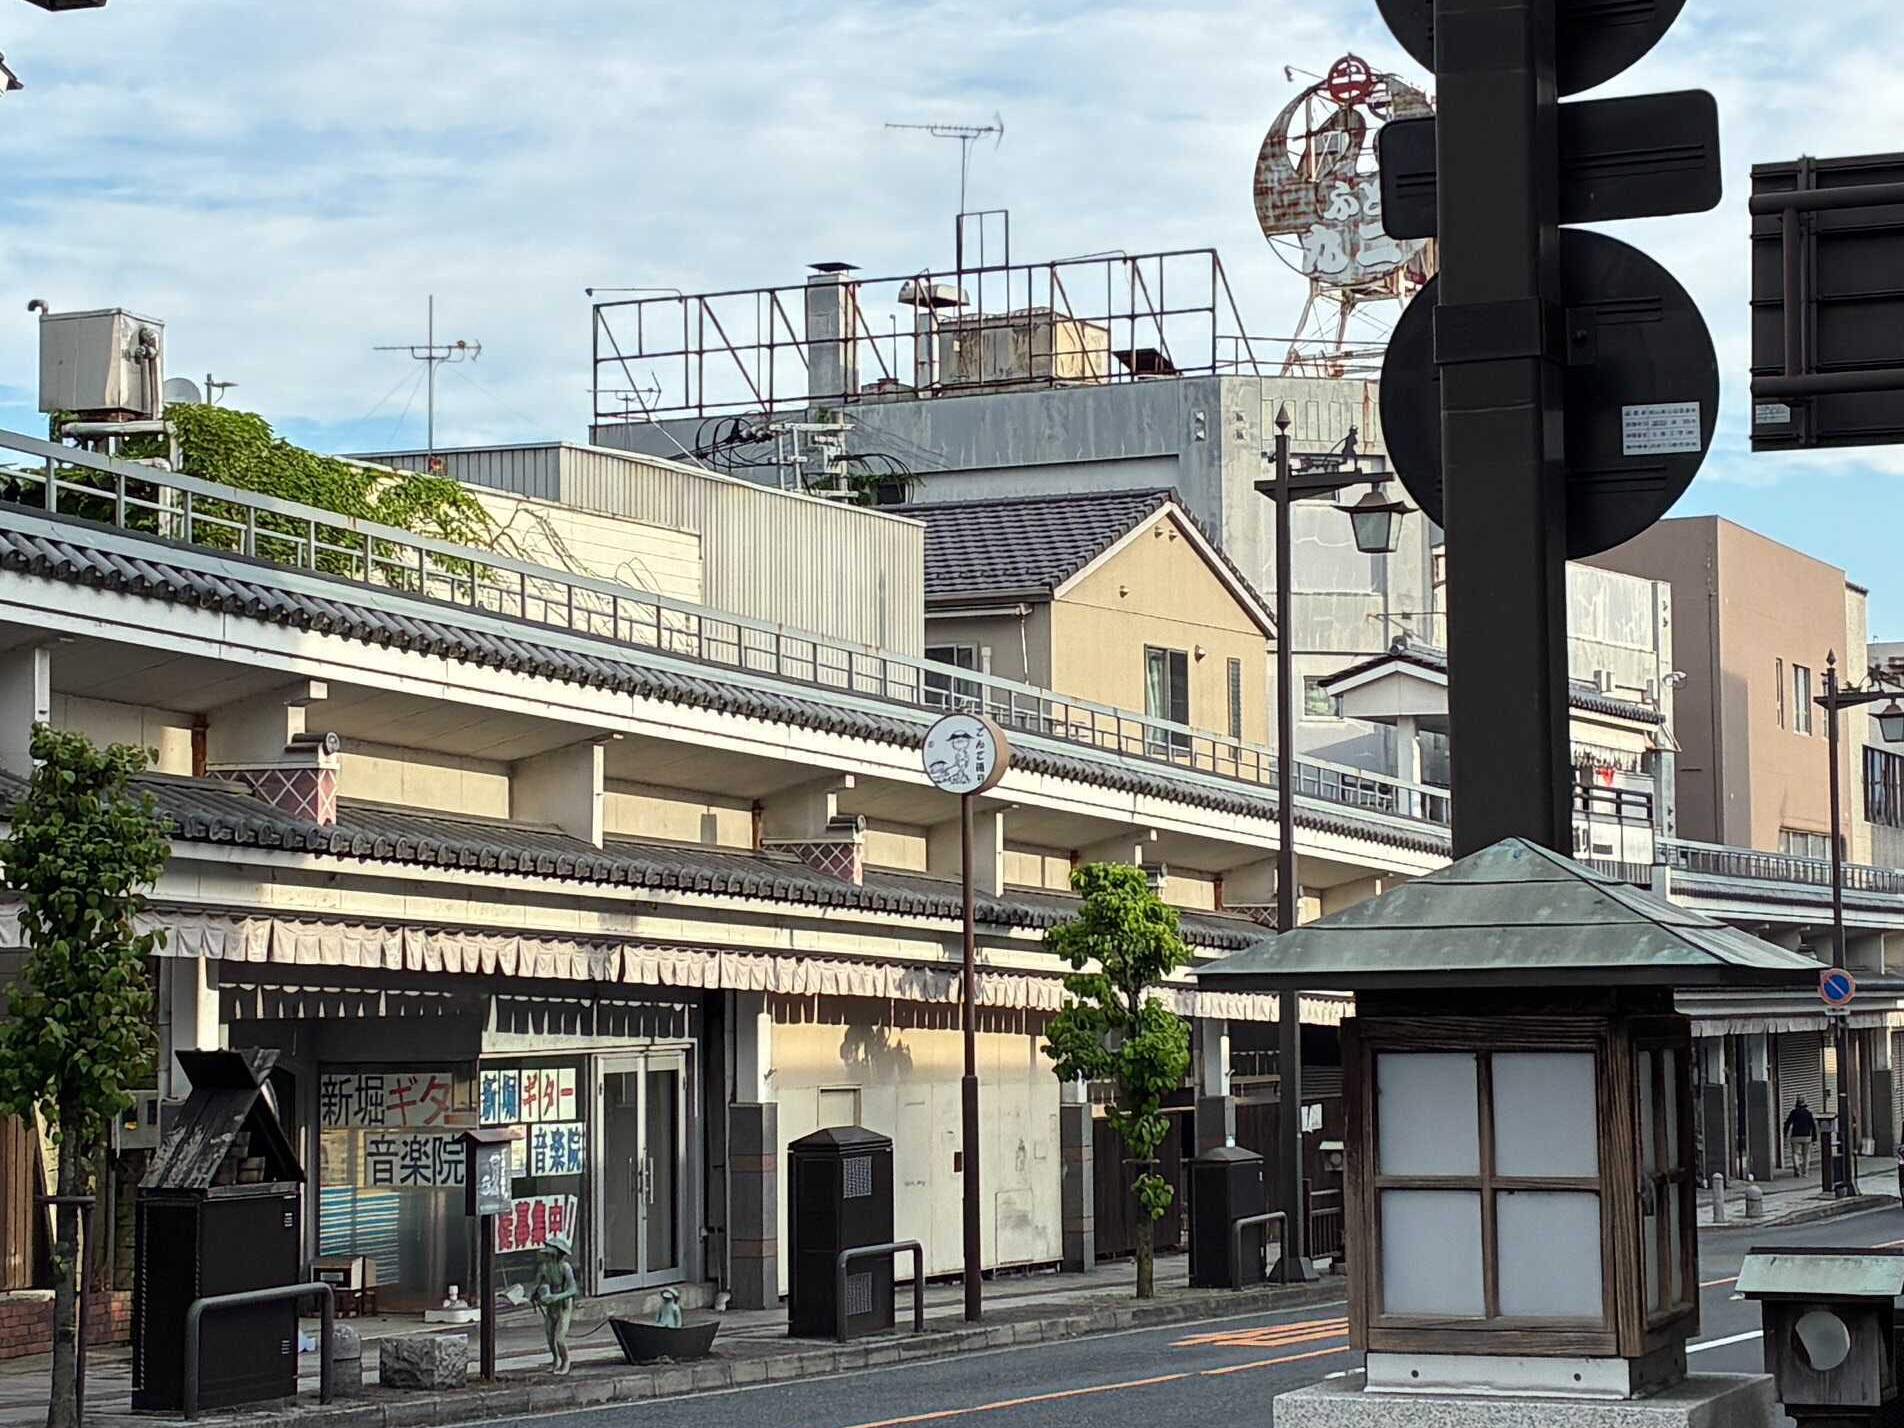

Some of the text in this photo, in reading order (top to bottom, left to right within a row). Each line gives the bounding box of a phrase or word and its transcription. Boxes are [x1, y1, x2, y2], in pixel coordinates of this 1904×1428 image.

[367, 1133, 466, 1186] 音楽院
[533, 1126, 581, 1173] 音楽院
